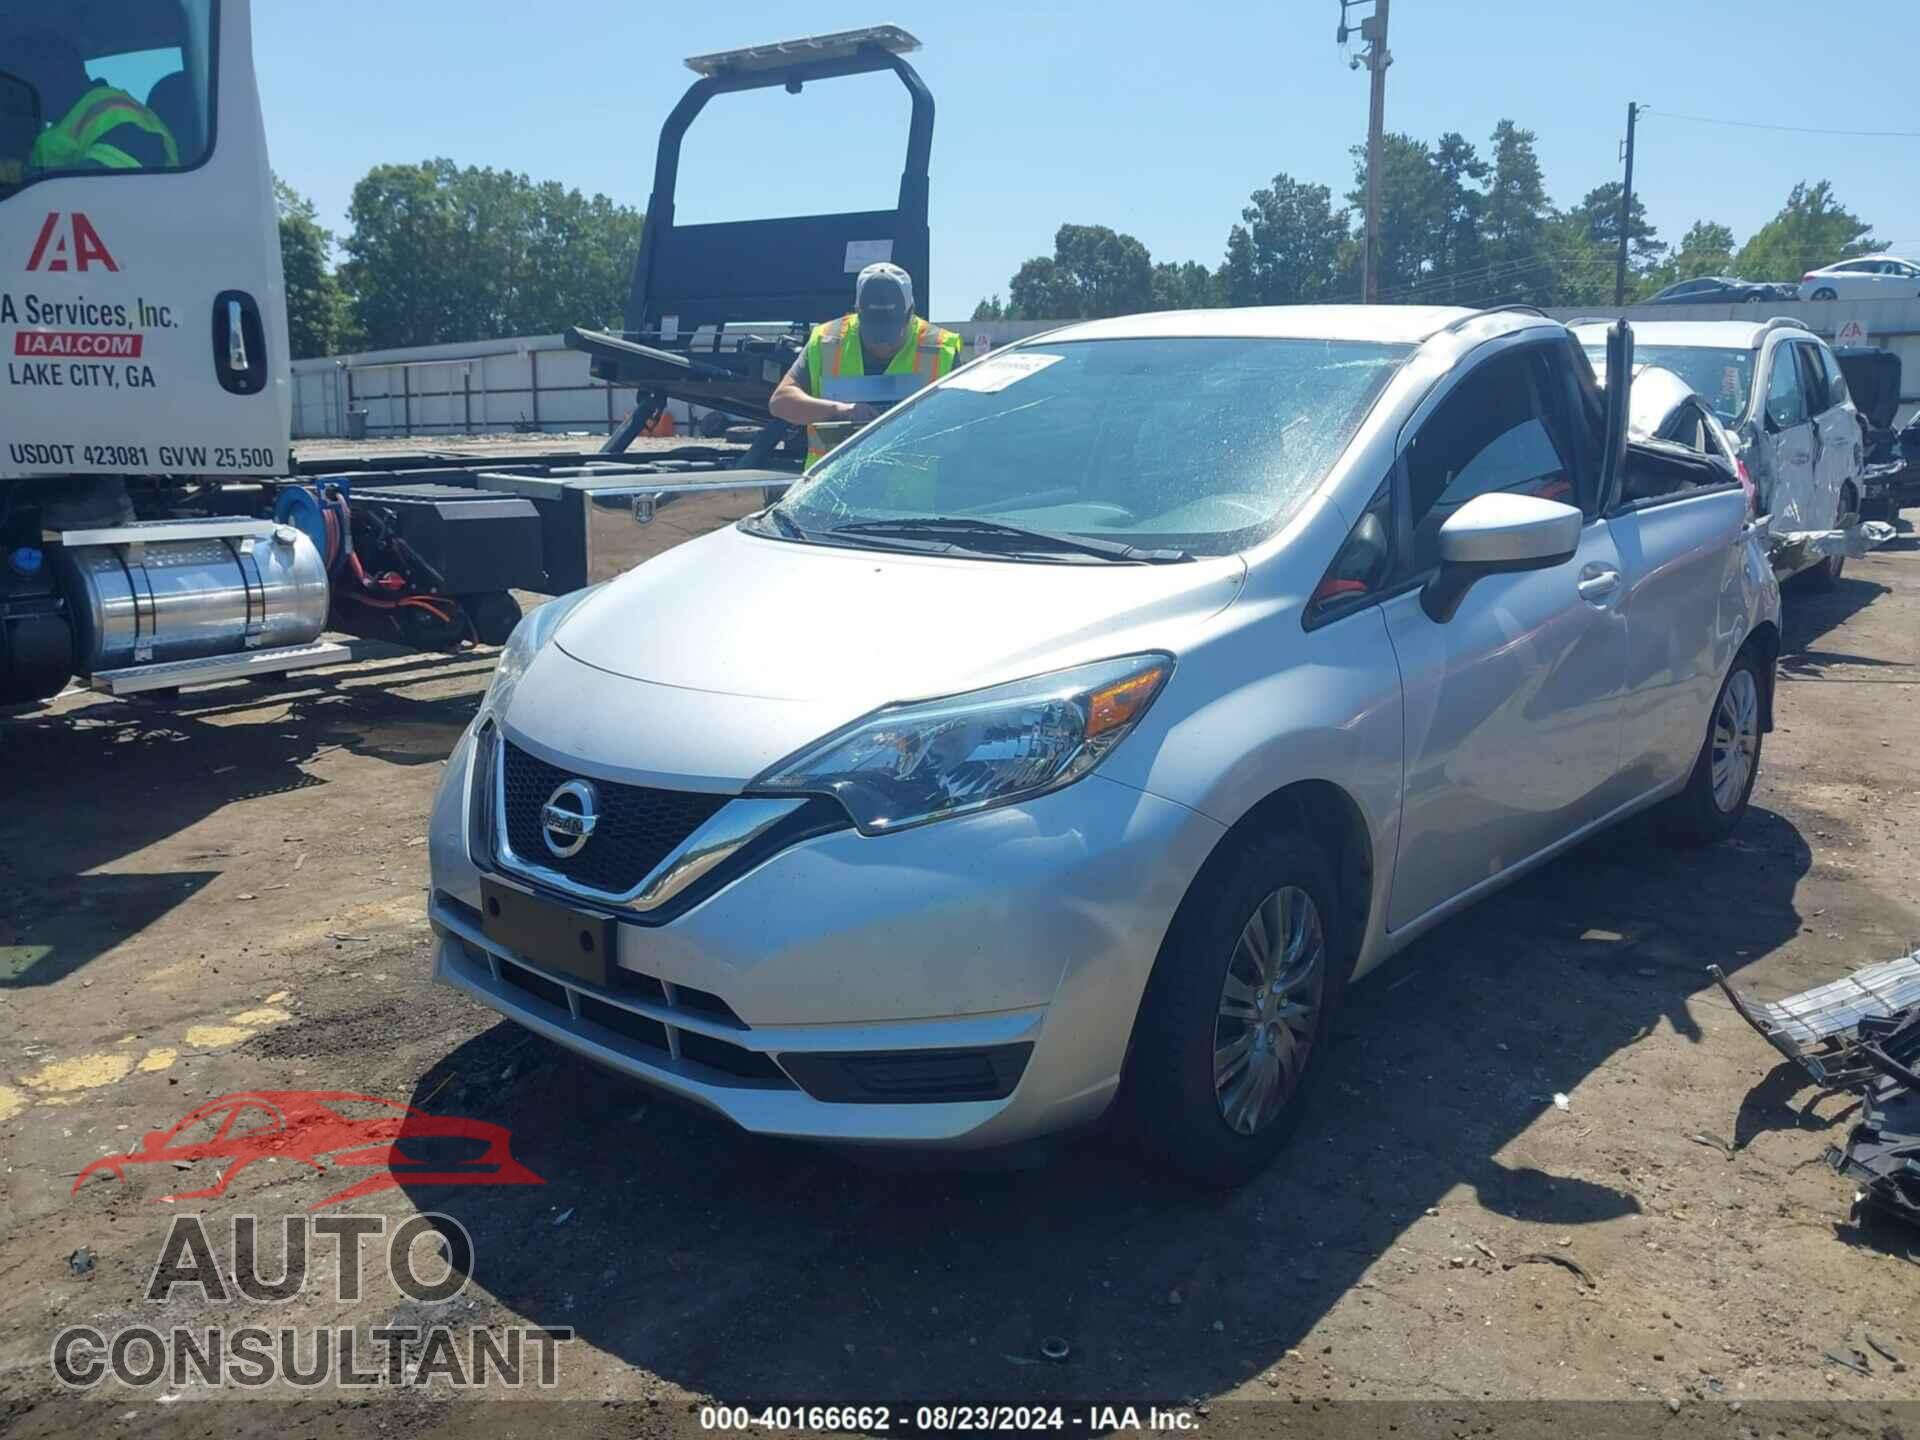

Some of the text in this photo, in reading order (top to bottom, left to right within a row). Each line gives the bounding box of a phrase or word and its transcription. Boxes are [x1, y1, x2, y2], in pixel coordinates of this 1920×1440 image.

[25, 294, 133, 330] Services,
[138, 297, 178, 329] Inc.
[23, 334, 133, 354] IAAI.COM
[8, 362, 156, 390] LAKE CITY, GA
[9, 444, 274, 469] USDOT 423081 GVW 25,500
